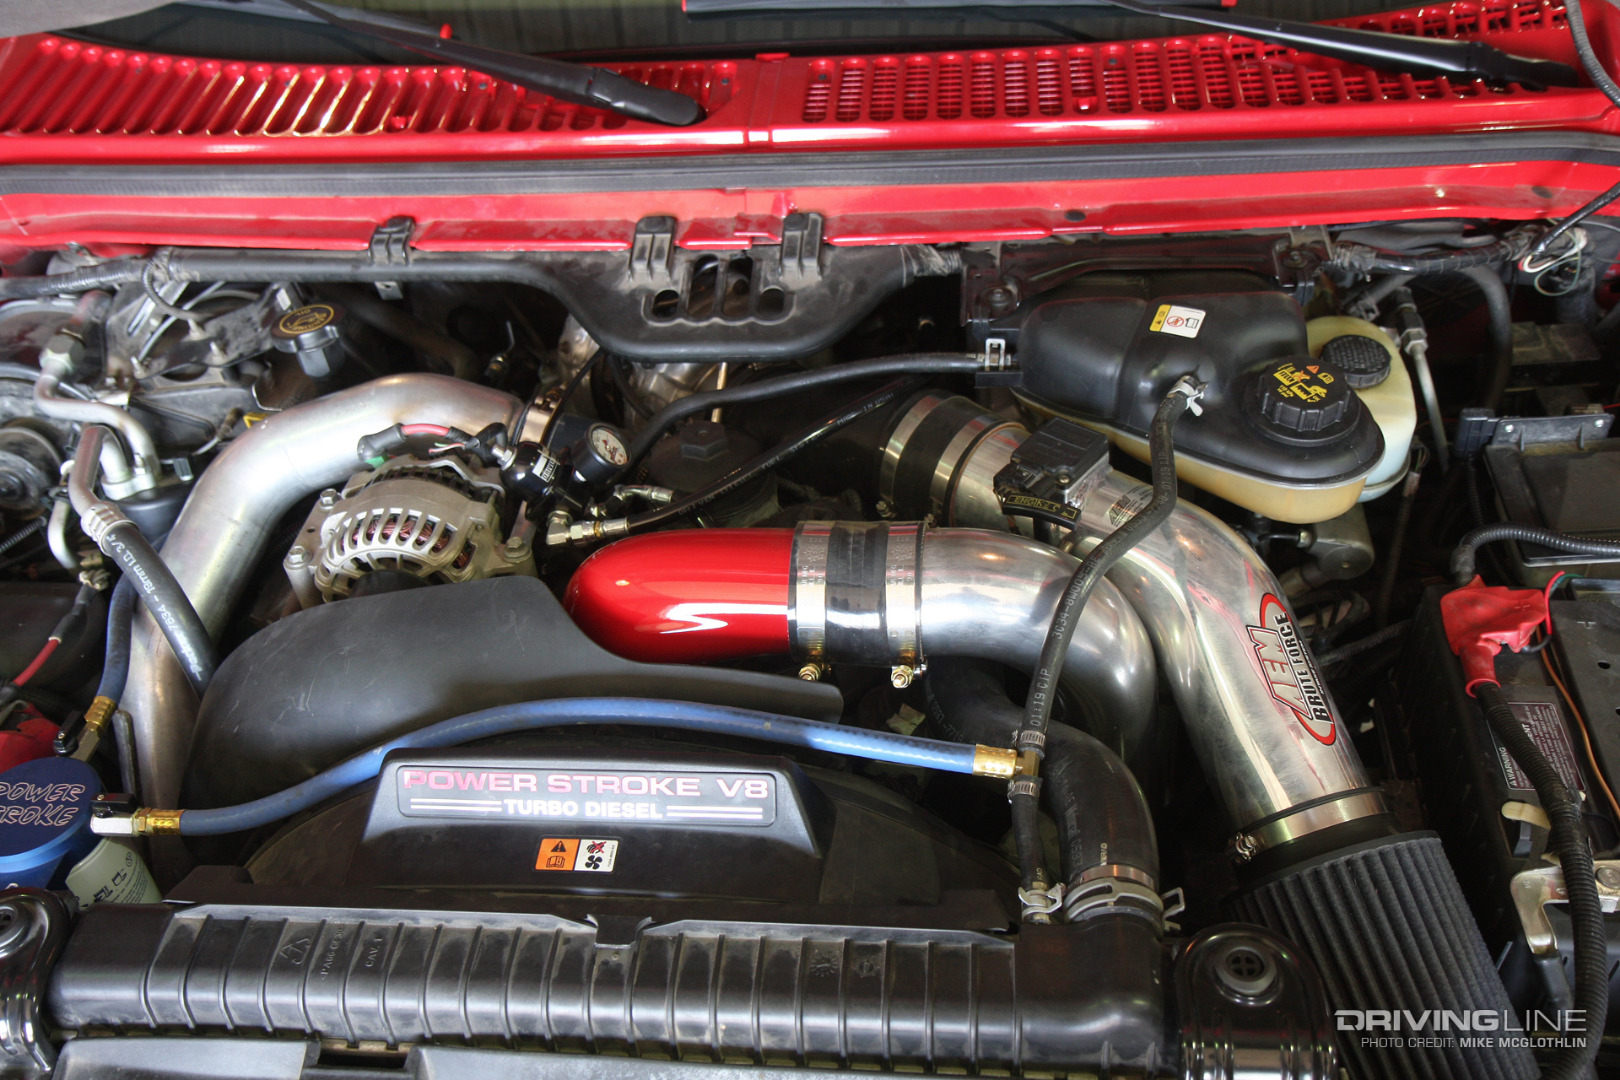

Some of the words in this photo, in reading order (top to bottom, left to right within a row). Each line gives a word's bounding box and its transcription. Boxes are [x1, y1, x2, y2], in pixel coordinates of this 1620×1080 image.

[1272, 611, 1304, 667] FORCE
[1246, 625, 1313, 720] AEM
[1296, 669, 1334, 724] BRUTE
[403, 770, 538, 793] POWER
[548, 774, 701, 797] STROKE
[716, 778, 769, 799] V8
[1498, 746, 1517, 781] WARNING
[503, 798, 579, 817] TURBO
[585, 800, 664, 820] DIESEL
